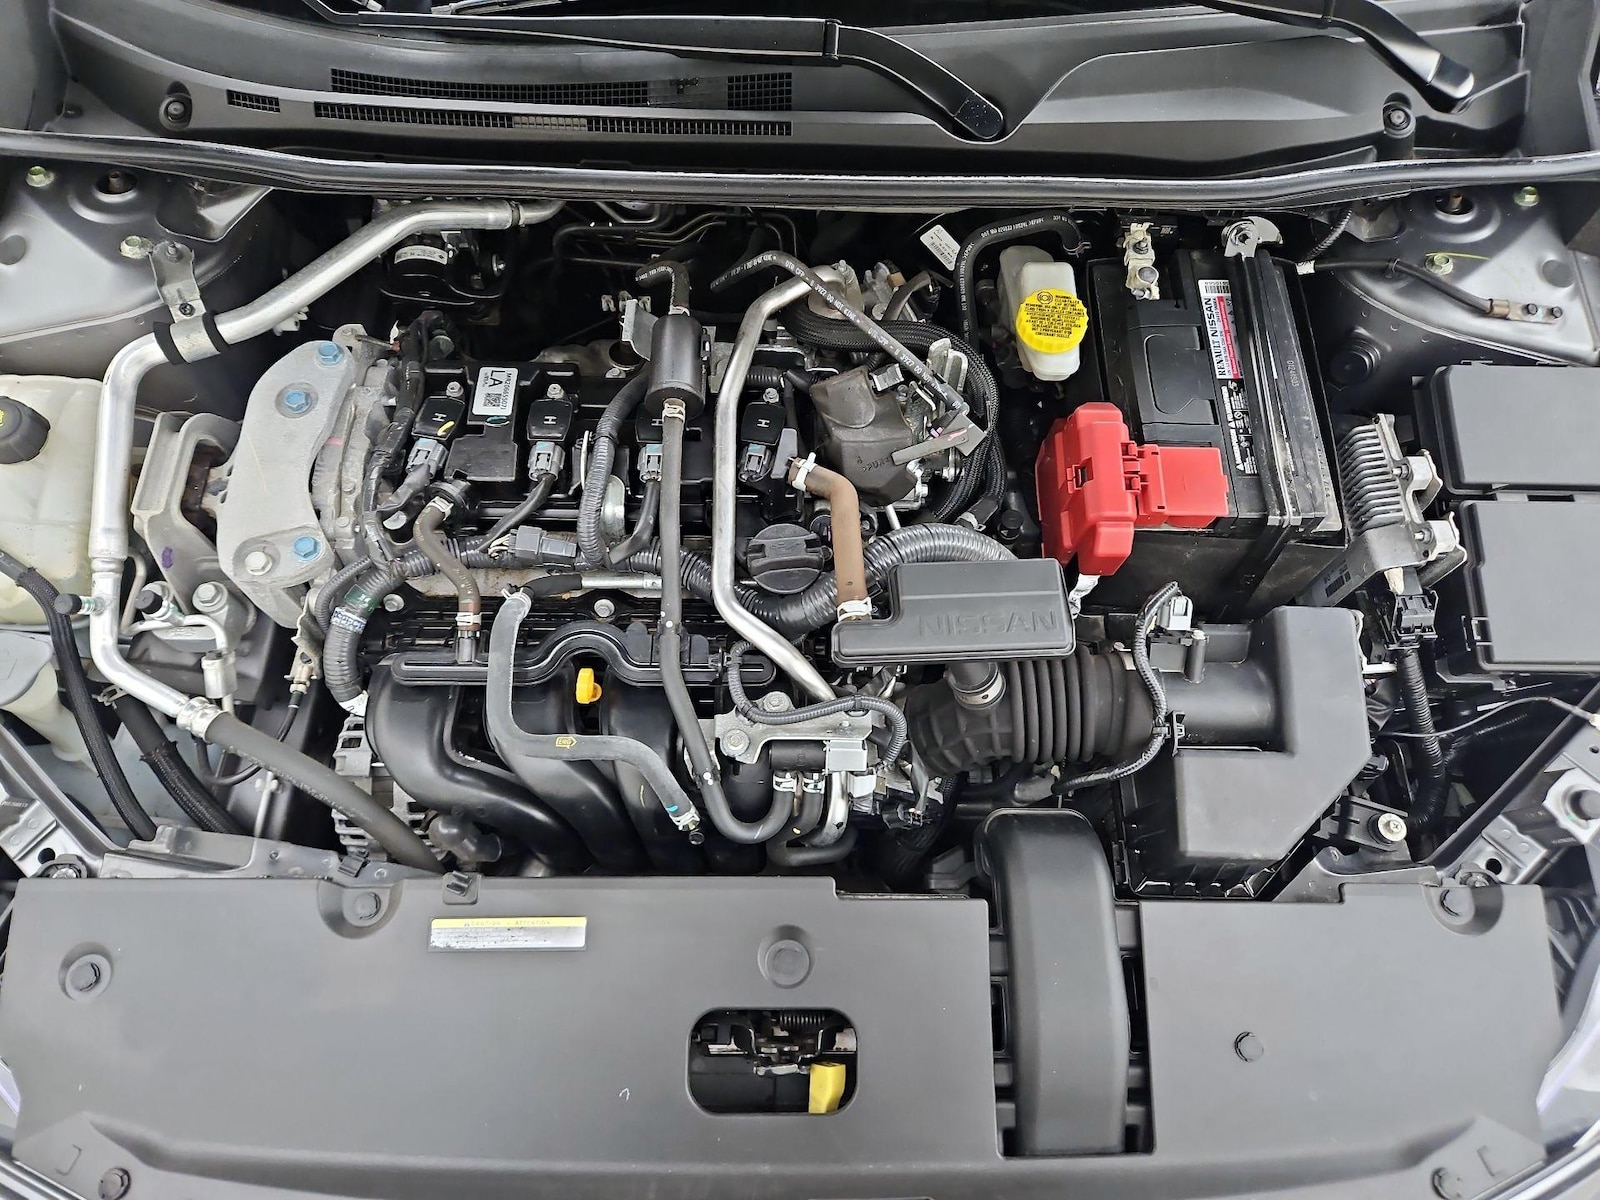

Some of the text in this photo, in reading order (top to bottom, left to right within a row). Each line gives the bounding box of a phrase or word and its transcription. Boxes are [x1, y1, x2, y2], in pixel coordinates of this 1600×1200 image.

[1204, 298, 1218, 337] NISSAN
[1212, 340, 1226, 376] RENAULT
[488, 369, 505, 388] LA
[917, 610, 1058, 636] NISSAN
